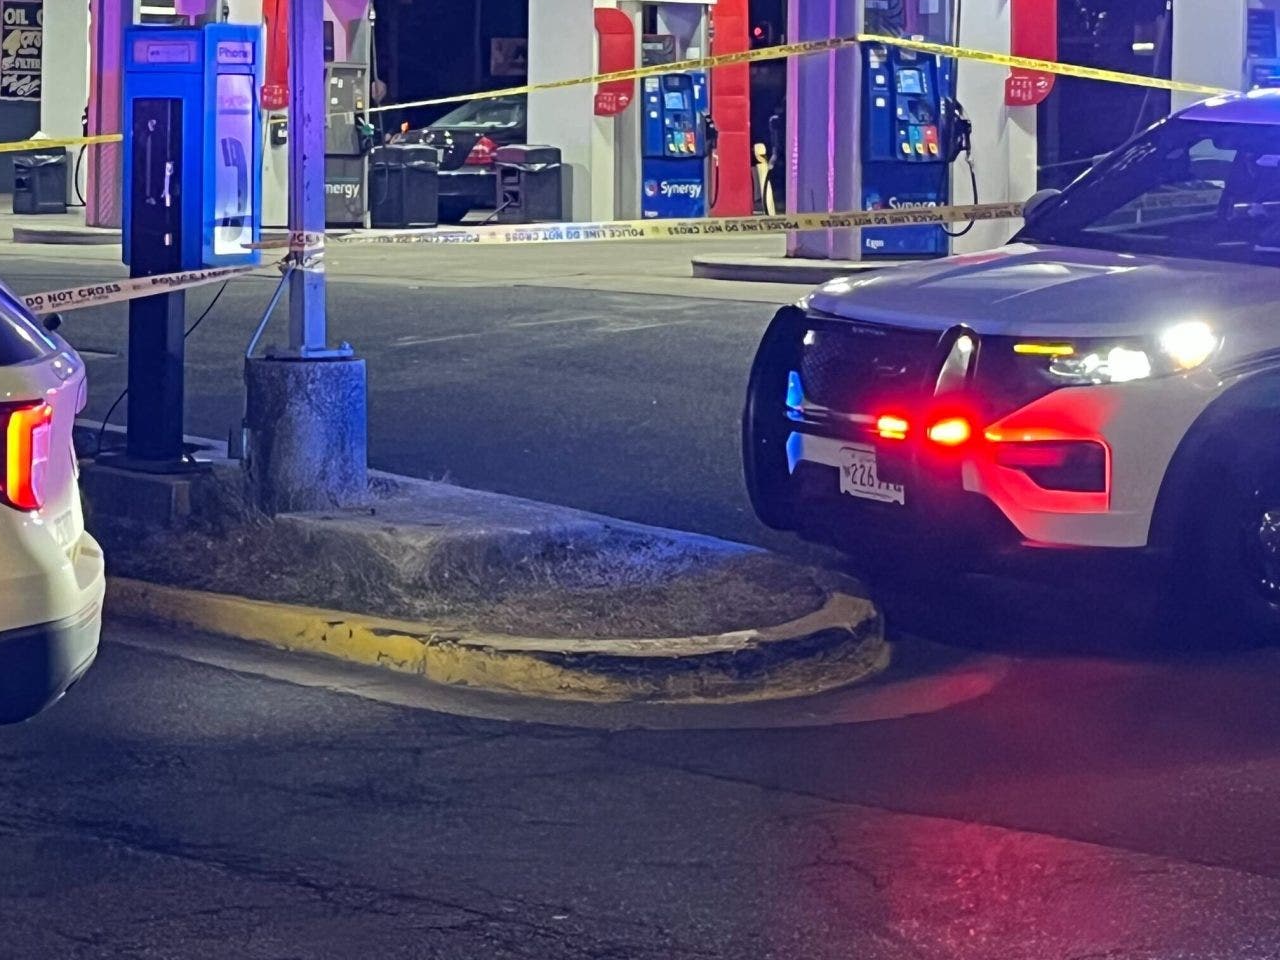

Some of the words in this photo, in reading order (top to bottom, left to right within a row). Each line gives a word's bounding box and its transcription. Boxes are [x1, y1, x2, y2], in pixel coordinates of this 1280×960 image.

[4, 8, 29, 25] OIL
[325, 183, 360, 198] nergy
[661, 181, 701, 198] Synergy
[583, 227, 606, 239] LINE
[609, 225, 645, 237] POLICE
[667, 226, 700, 236] CROSS
[703, 225, 722, 234] NOT
[725, 224, 739, 232] DO
[505, 230, 539, 242] CROSS
[542, 229, 563, 240] NOT
[25, 295, 44, 307] DO
[48, 291, 73, 303] NOT
[78, 283, 121, 298] CROSS
